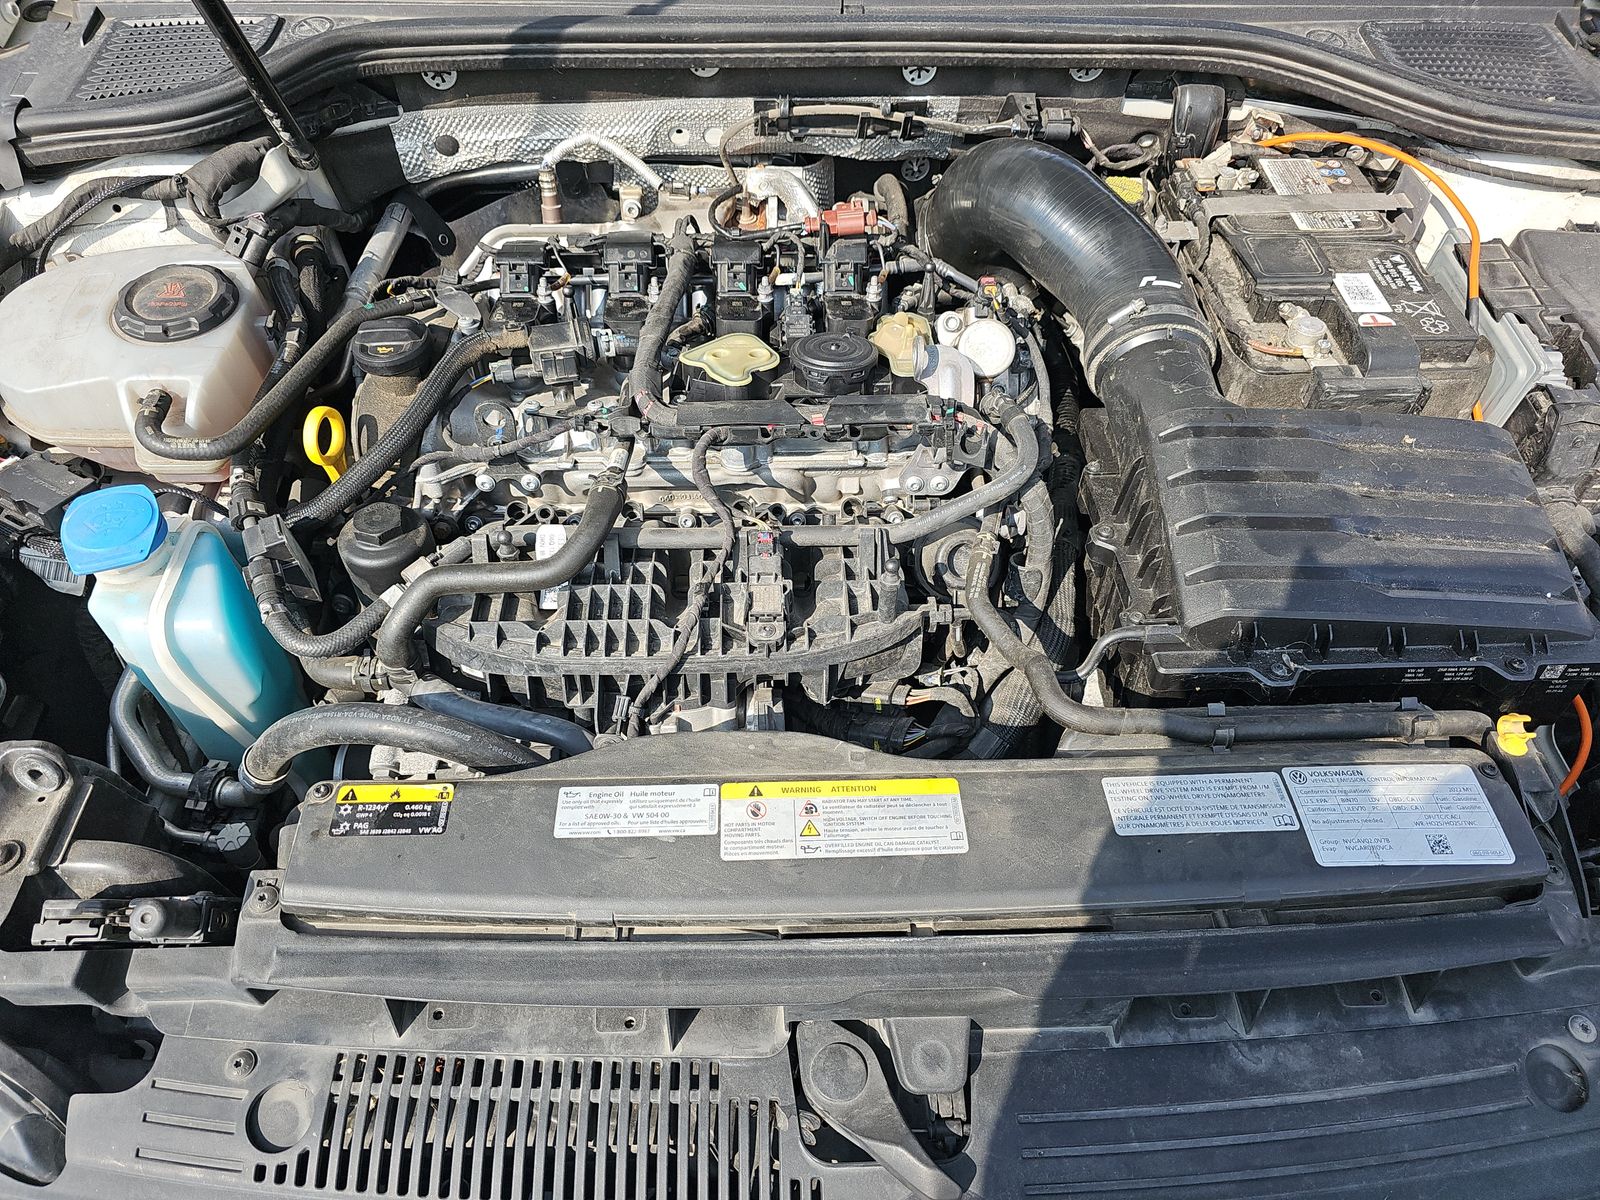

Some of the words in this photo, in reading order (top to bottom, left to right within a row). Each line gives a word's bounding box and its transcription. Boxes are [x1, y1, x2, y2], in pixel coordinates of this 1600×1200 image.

[1397, 264, 1424, 294] VARTA
[1392, 304, 1403, 313] Pb
[358, 804, 389, 813] R-1234yf
